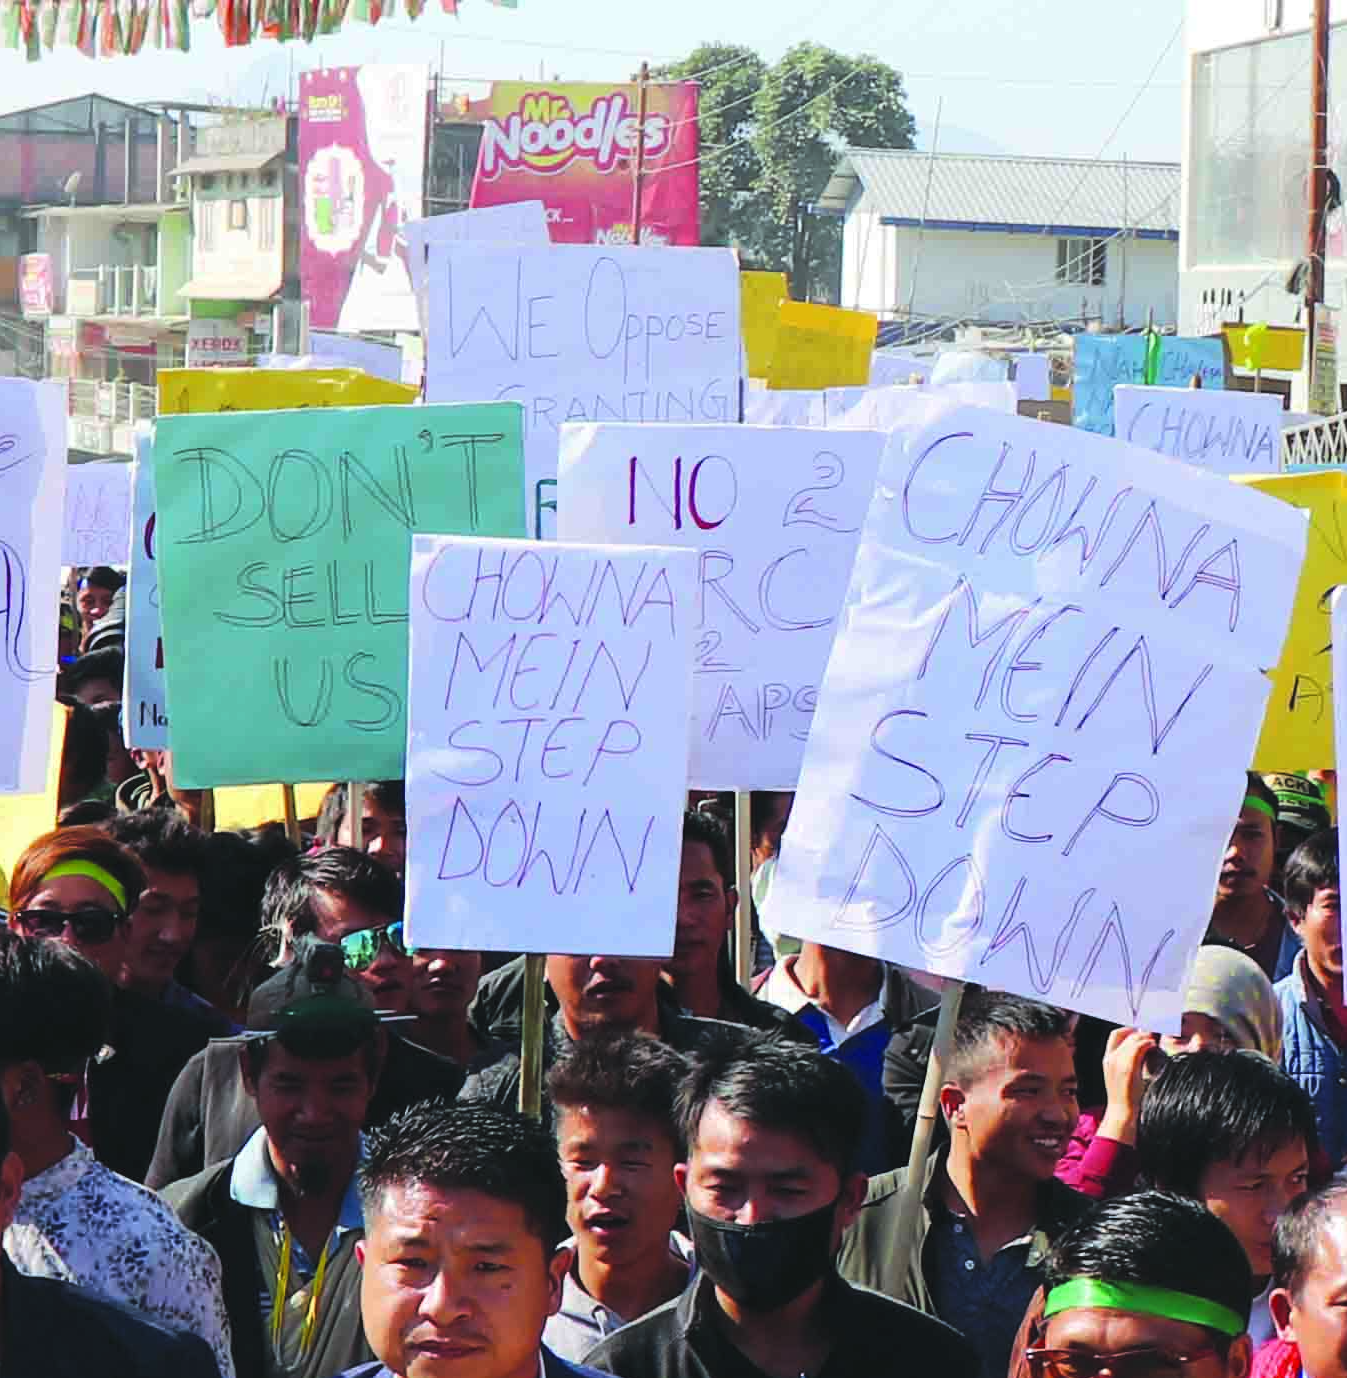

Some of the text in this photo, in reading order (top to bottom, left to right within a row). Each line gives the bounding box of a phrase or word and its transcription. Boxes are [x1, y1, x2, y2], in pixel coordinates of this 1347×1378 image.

[482, 95, 668, 173] Noodles
[447, 256, 560, 361] WE
[1127, 401, 1275, 466] CHOWNA
[172, 428, 507, 545] DON'T
[629, 455, 738, 530] NO
[782, 450, 860, 534] 2
[902, 431, 1243, 633] CHOWNA
[212, 559, 411, 630] SELL
[421, 543, 679, 639] CHOWNA
[698, 547, 835, 634] RC
[272, 650, 406, 733] US
[443, 630, 653, 713] MEIN
[917, 572, 1215, 757] MEIN
[430, 716, 643, 788] STEP
[850, 709, 1162, 857] STEP
[436, 796, 656, 895] DOWN
[831, 822, 1177, 1021] DOWN
